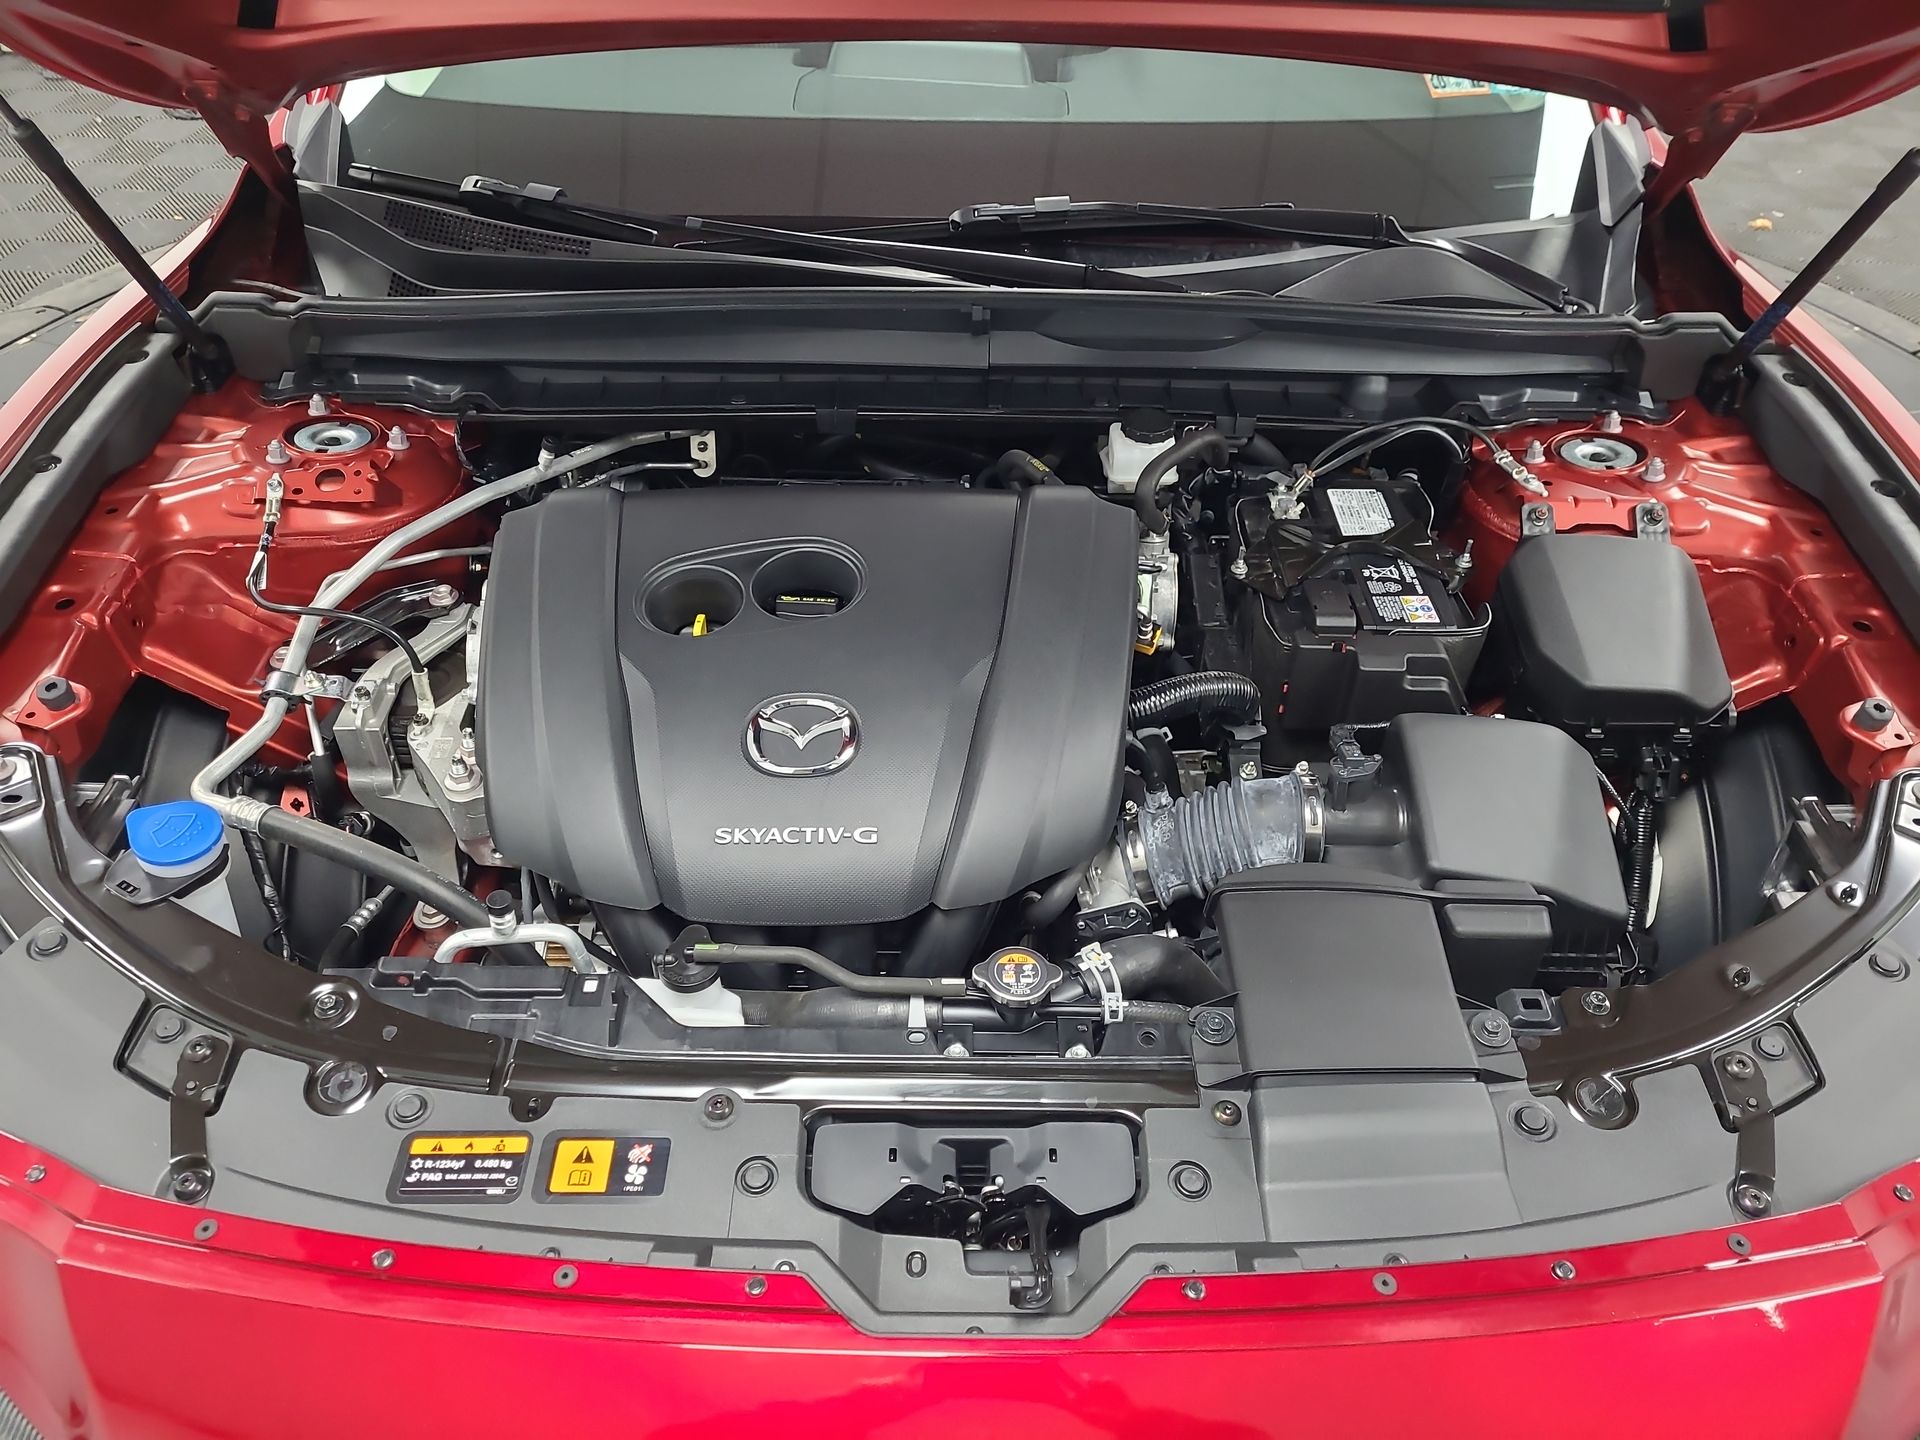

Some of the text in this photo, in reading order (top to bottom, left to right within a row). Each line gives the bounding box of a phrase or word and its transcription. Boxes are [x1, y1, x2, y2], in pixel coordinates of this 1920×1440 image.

[714, 826, 879, 845] SKYACTIV-G
[424, 1159, 466, 1170] R-1234yf
[499, 1159, 513, 1169] kg
[420, 1172, 443, 1181] PAG
